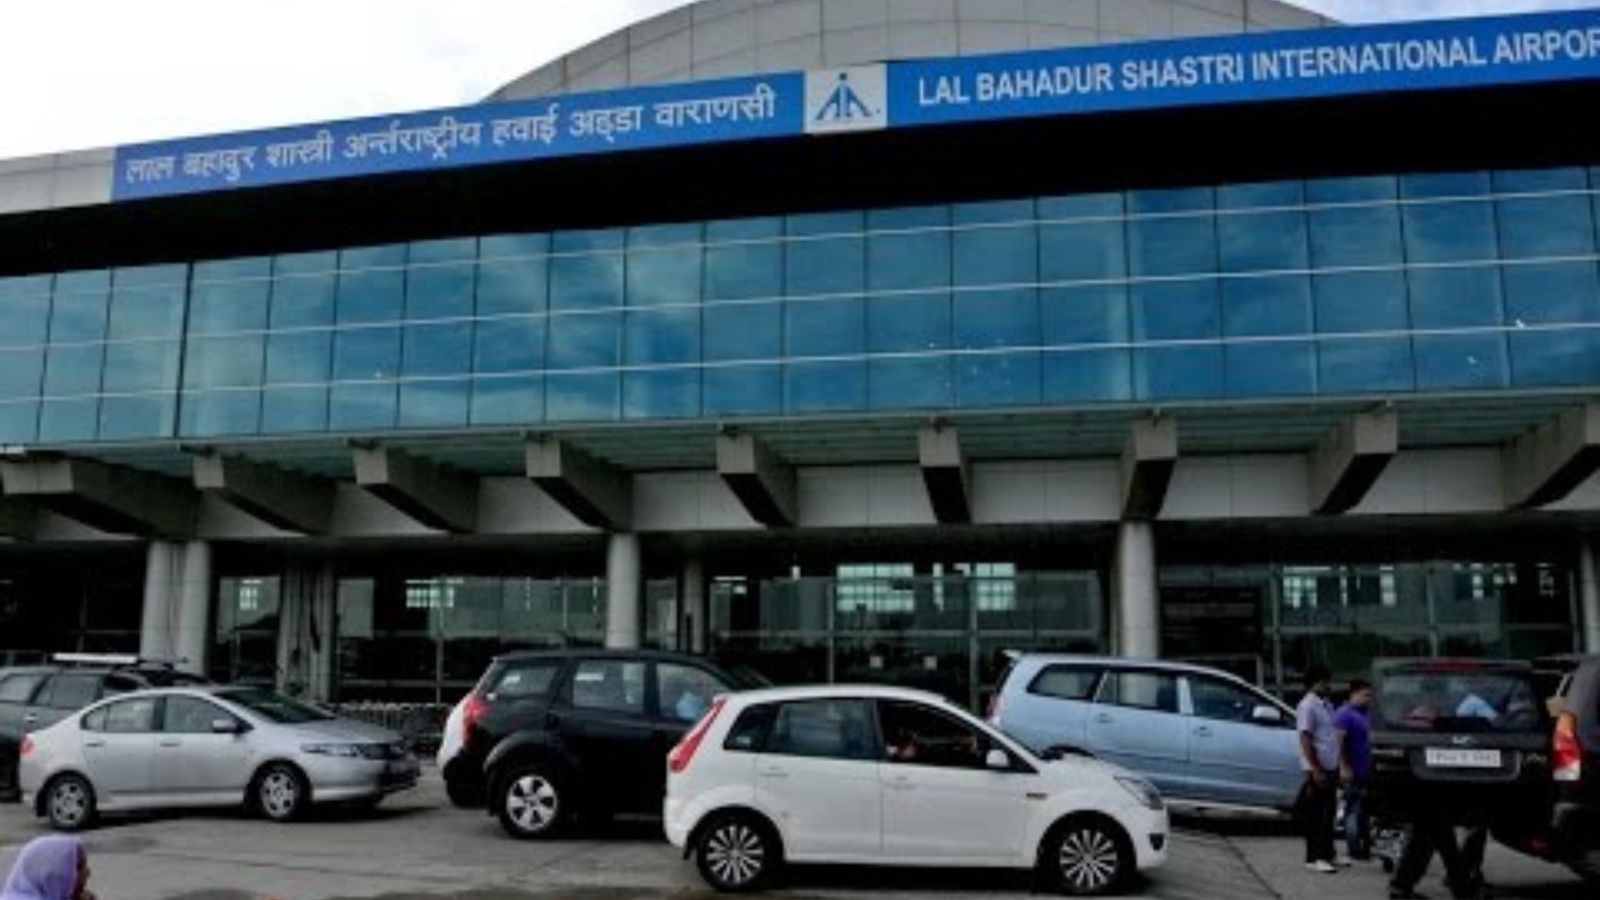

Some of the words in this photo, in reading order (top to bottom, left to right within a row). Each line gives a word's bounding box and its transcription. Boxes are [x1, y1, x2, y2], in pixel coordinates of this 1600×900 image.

[919, 76, 970, 106] LAL
[976, 63, 1113, 101] BAHADUR
[1121, 53, 1244, 90] SHASTRI
[1252, 36, 1487, 81] INTERNATIONAL
[125, 156, 175, 184] लाल
[266, 130, 334, 167] शास्त्री
[492, 103, 560, 145] हवाई
[654, 83, 776, 127] वाराणसी
